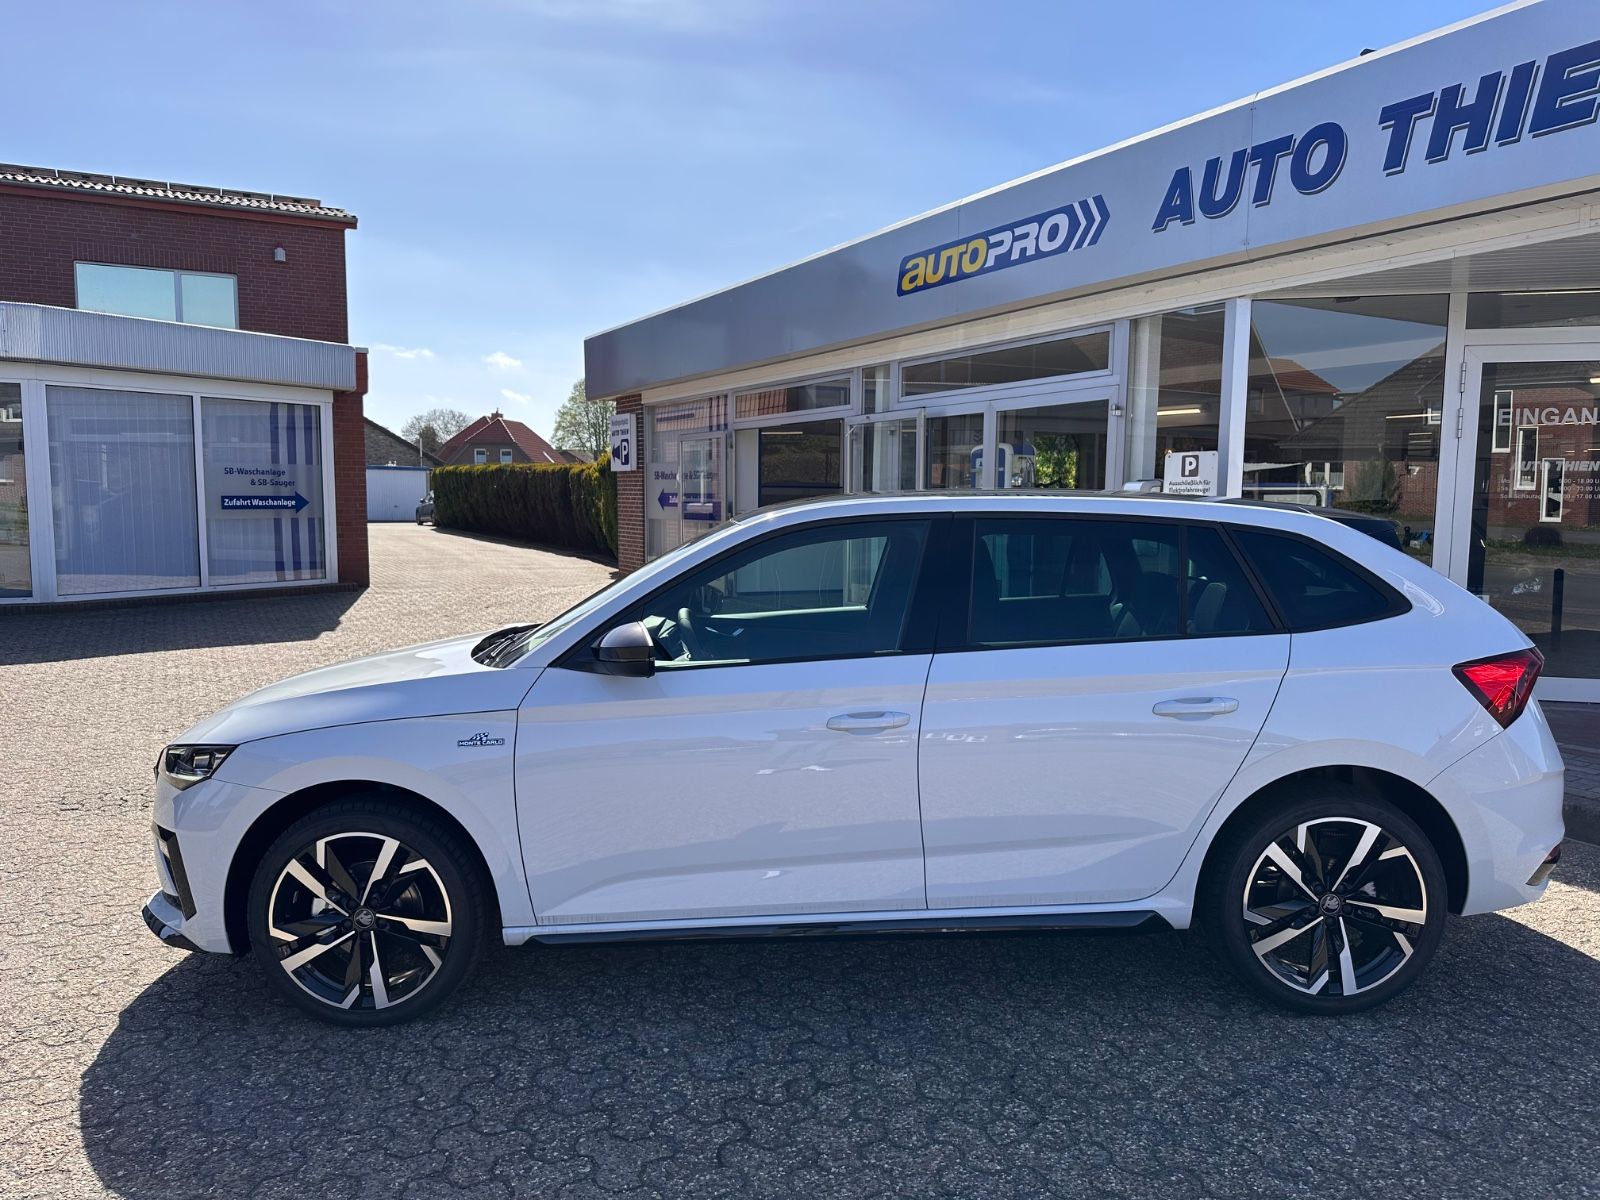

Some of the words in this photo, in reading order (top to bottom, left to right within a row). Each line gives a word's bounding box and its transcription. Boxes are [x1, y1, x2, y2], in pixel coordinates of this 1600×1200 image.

[1151, 121, 1349, 234] AUTO
[1378, 39, 1600, 178] THIE
[621, 441, 629, 463] P
[224, 467, 286, 477] SB-Waschanlage
[1185, 456, 1197, 476] P
[223, 498, 251, 506] Zufahrt
[251, 498, 296, 507] Waschanlage
